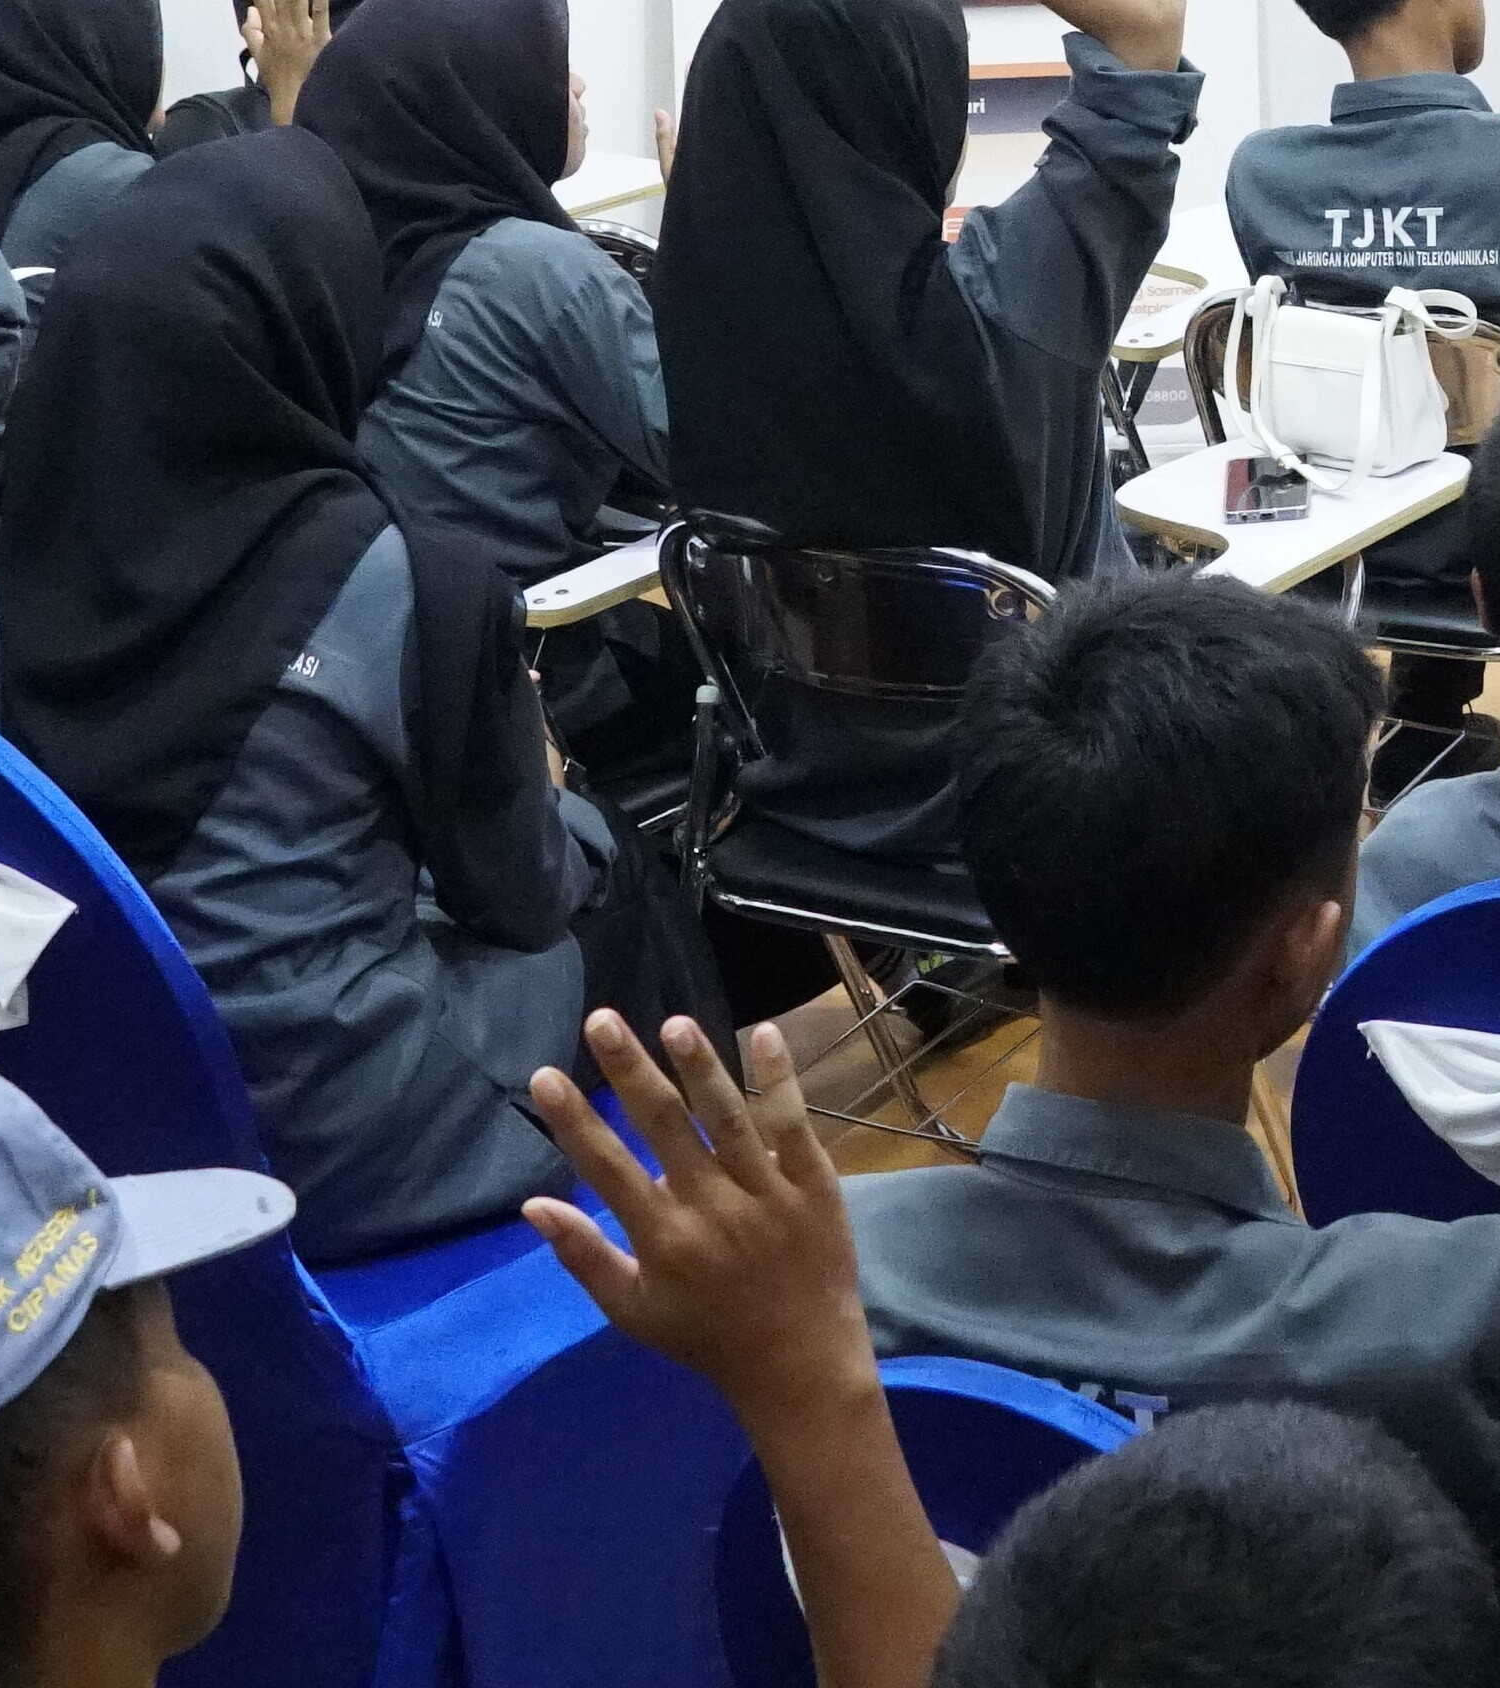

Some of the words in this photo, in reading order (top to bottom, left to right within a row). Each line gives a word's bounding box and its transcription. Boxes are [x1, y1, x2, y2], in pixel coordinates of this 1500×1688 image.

[1324, 206, 1444, 248] TJKT
[1296, 250, 1342, 267] JARINGAN
[1343, 250, 1395, 268] KOMPUTER
[1395, 250, 1415, 267] DAN
[1416, 249, 1499, 267] TELEKOMUNIKASI
[7, 1230, 98, 1333] CIPANAS
